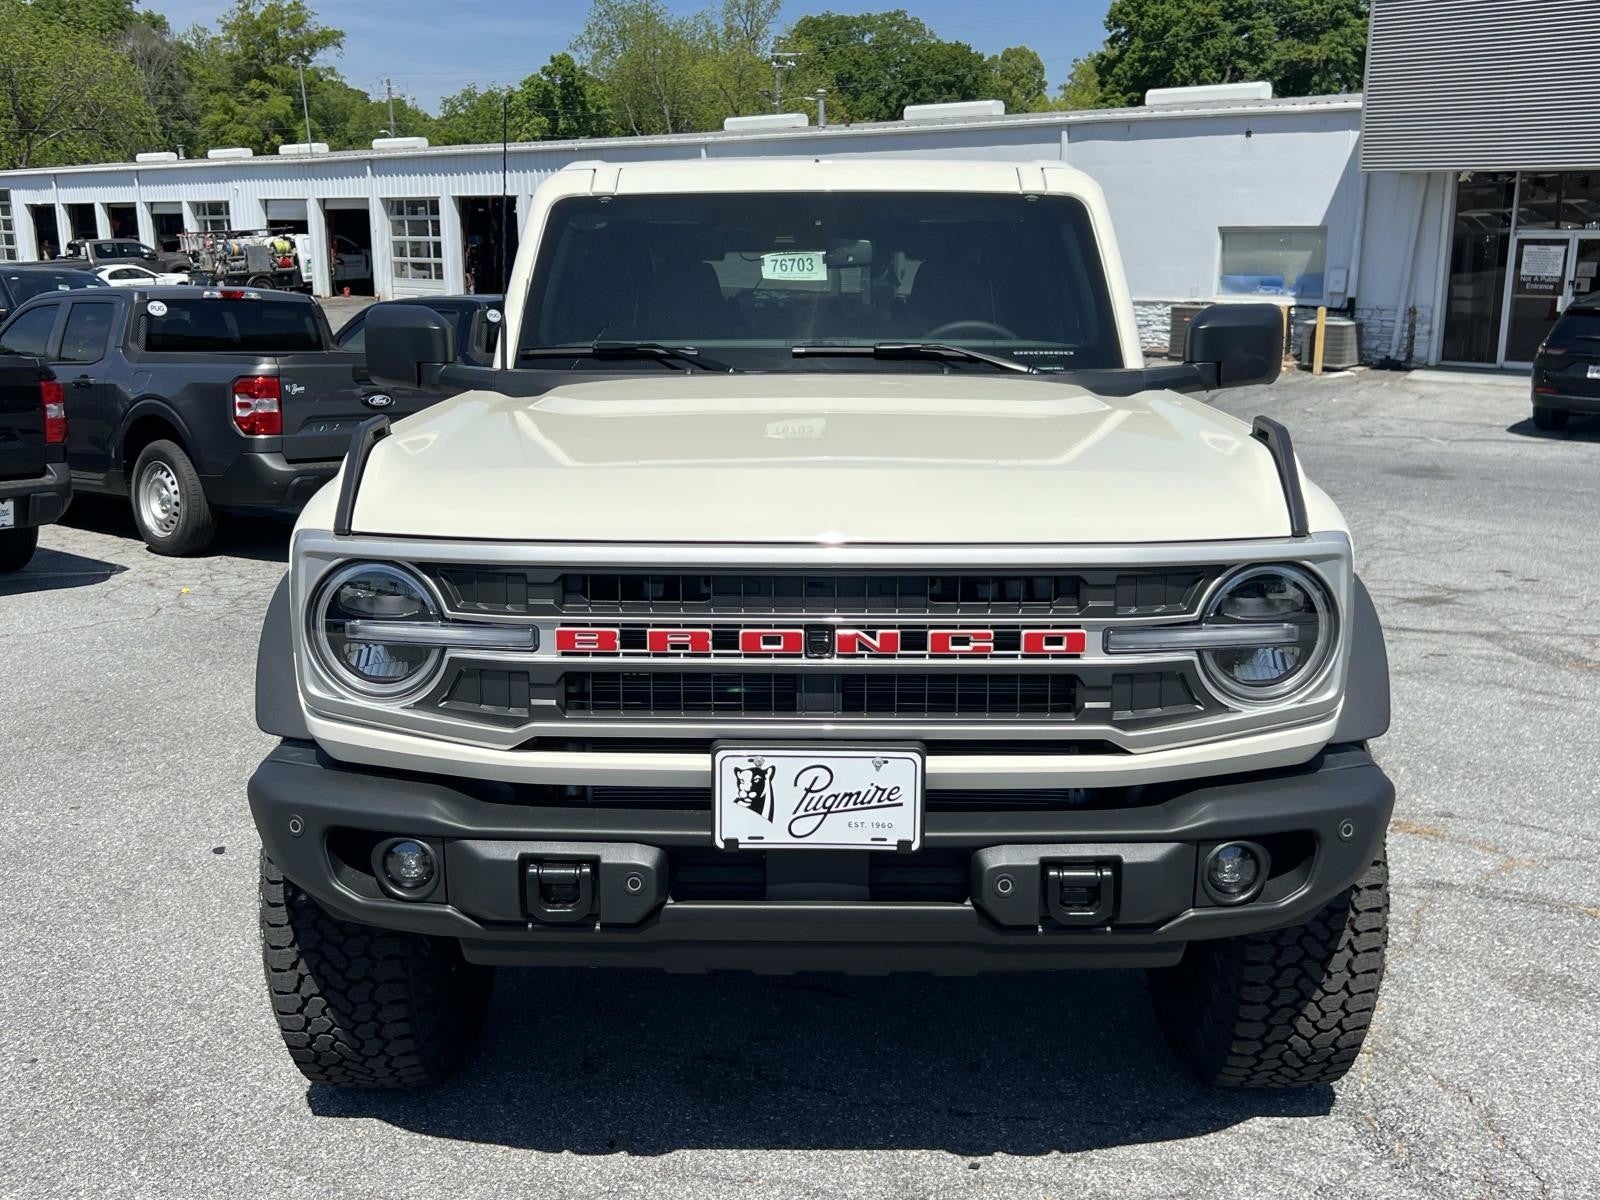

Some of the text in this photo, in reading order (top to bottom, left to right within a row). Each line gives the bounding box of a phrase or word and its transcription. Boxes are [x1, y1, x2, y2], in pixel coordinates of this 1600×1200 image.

[770, 257, 814, 272] 76703
[555, 627, 1087, 654] BRONCO
[788, 764, 903, 838] Pugmire
[848, 821, 893, 829] EST. 1960
